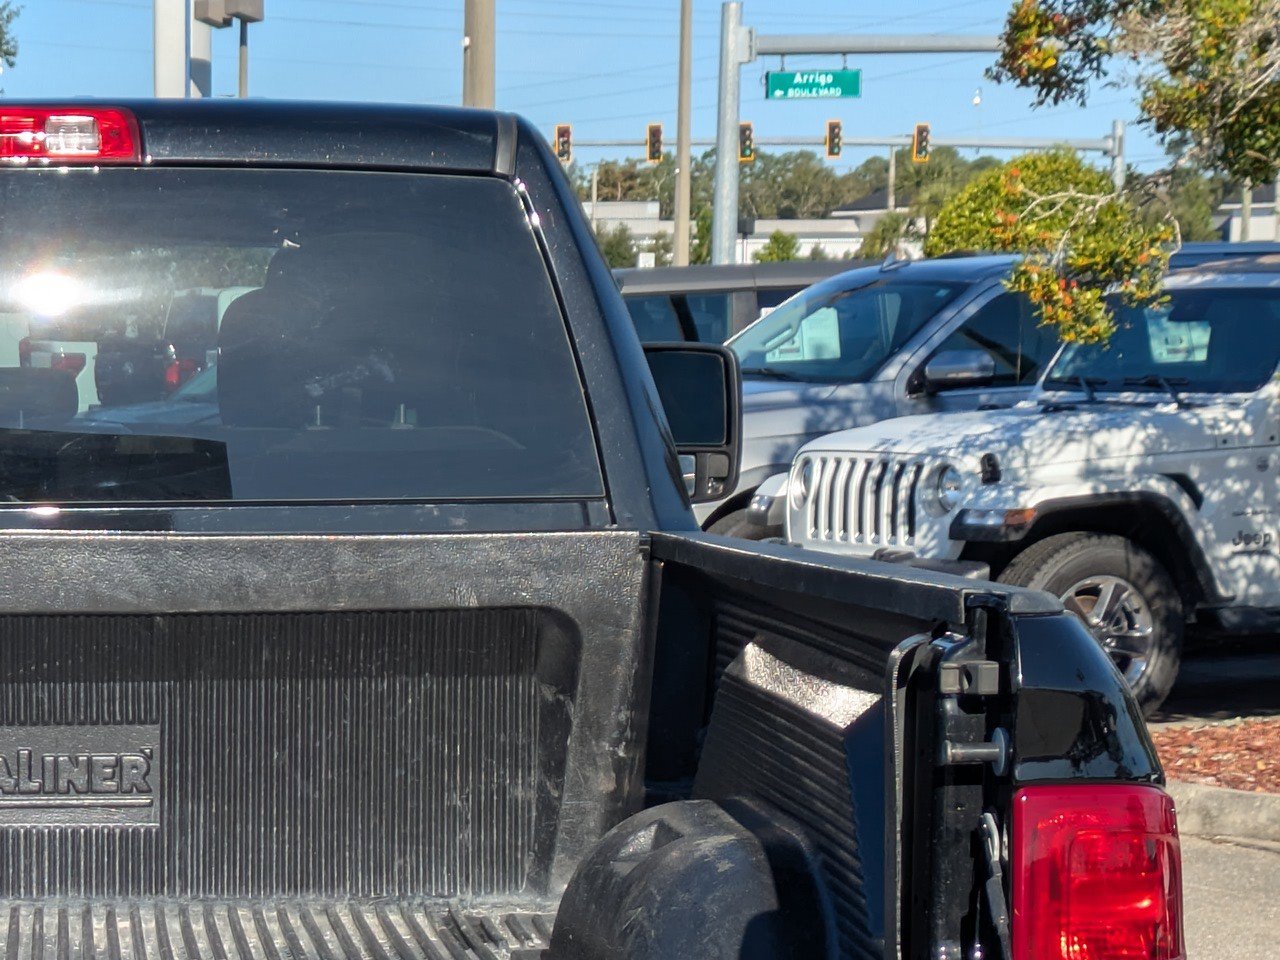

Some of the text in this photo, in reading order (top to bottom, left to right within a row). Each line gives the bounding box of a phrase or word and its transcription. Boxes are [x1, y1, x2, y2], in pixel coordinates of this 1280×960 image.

[793, 72, 834, 86] Arrigo
[787, 87, 842, 98] BOULEVARD
[1232, 530, 1271, 549] Jeep
